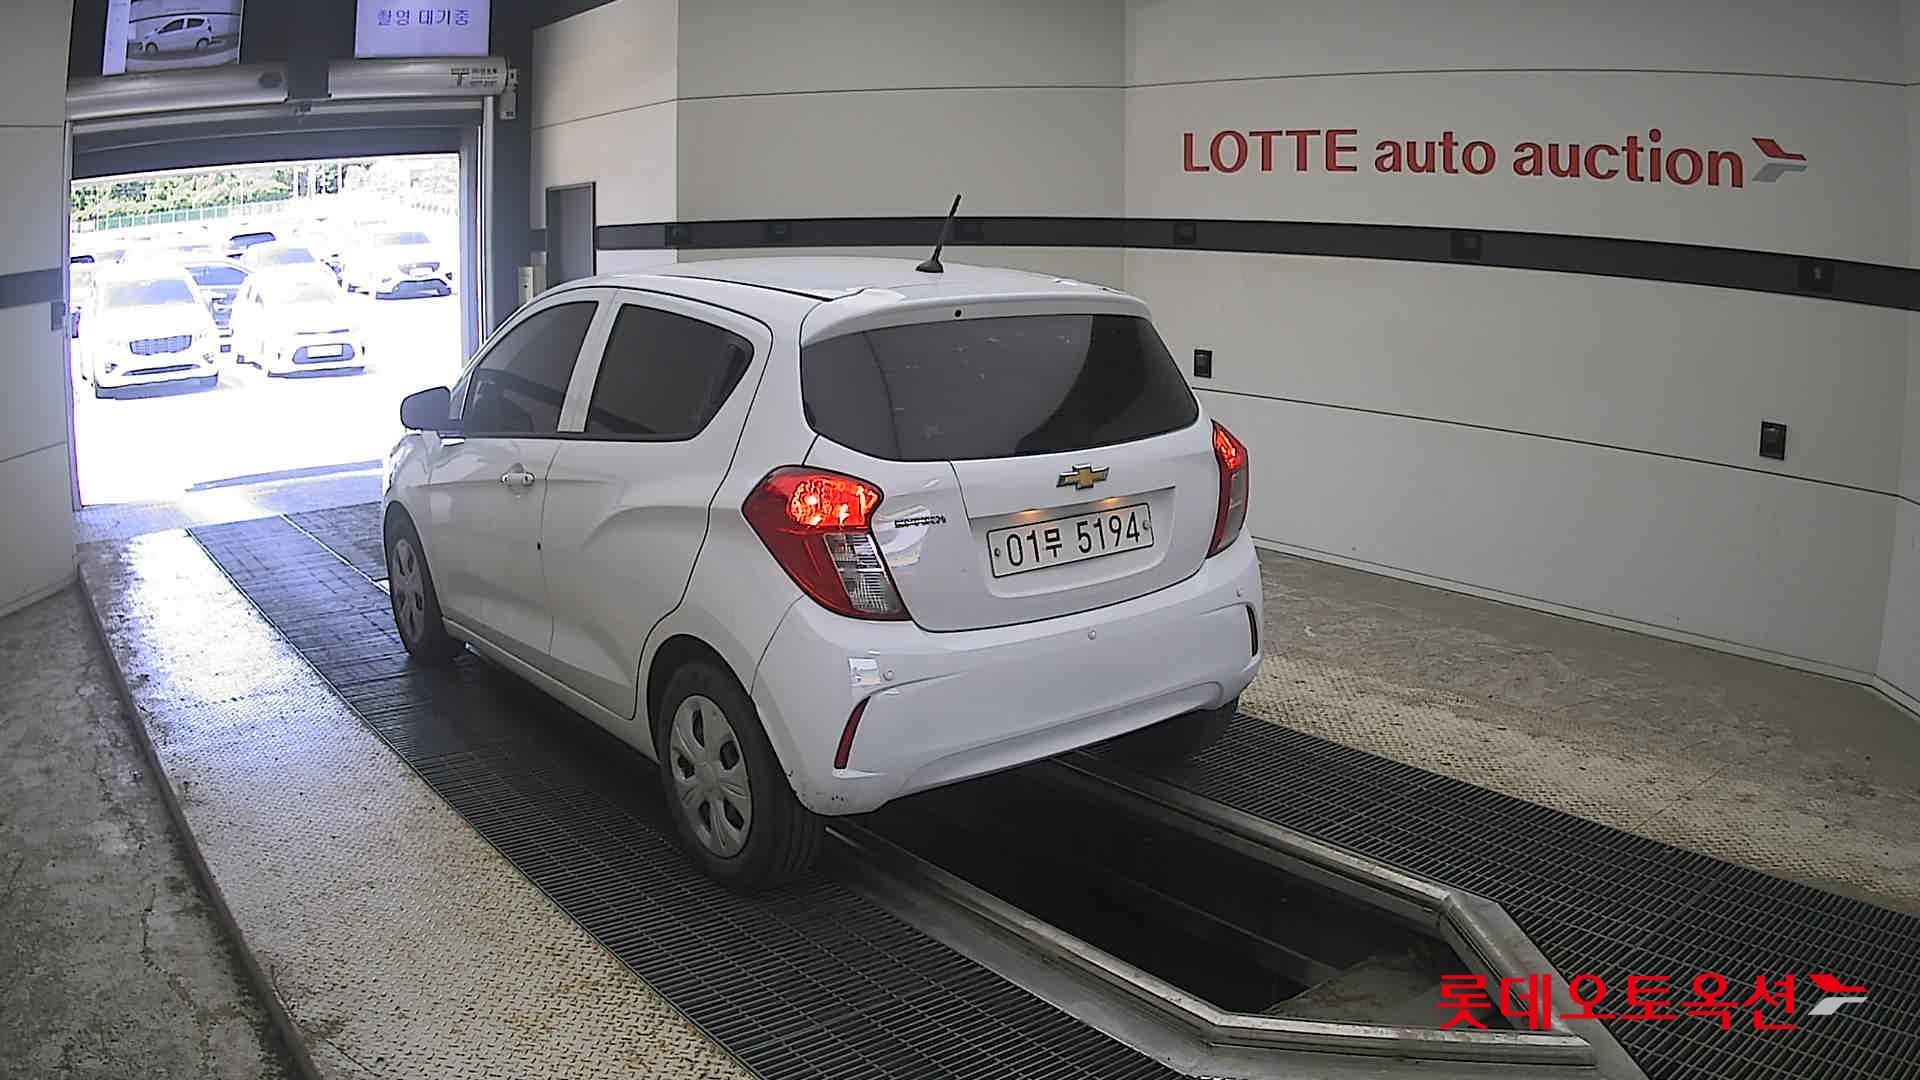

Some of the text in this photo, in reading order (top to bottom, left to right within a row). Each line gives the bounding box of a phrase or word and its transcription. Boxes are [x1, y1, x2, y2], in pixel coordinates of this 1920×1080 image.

[419, 9, 469, 26] 대기중
[1183, 128, 1743, 188] LOTTE auto auction
[1006, 511, 1141, 566] 01무 5194
